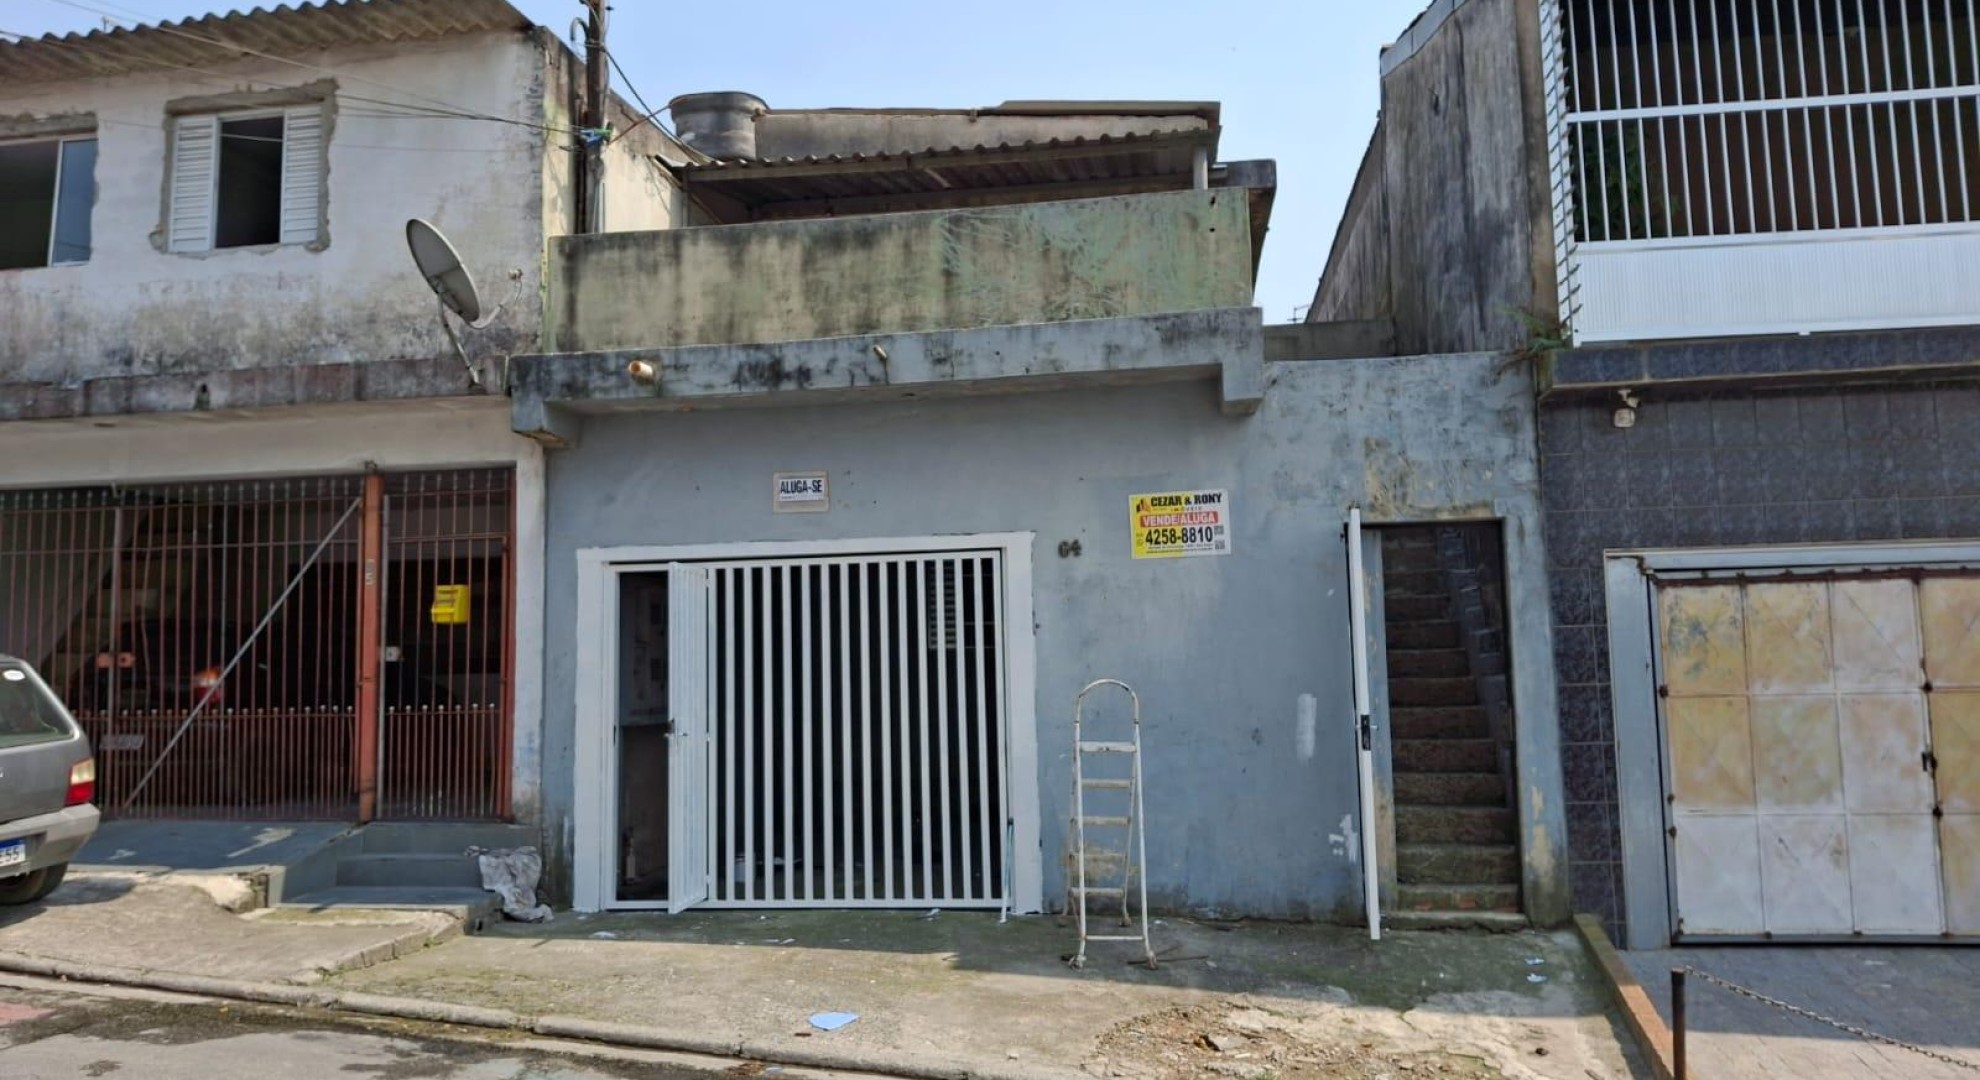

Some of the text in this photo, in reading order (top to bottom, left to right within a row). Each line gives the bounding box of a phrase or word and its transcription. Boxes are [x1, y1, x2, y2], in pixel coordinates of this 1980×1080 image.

[780, 479, 823, 493] ALUGA-SE
[1150, 493, 1222, 507] CEZAR & RONY
[1145, 526, 1214, 545] 4258-8810
